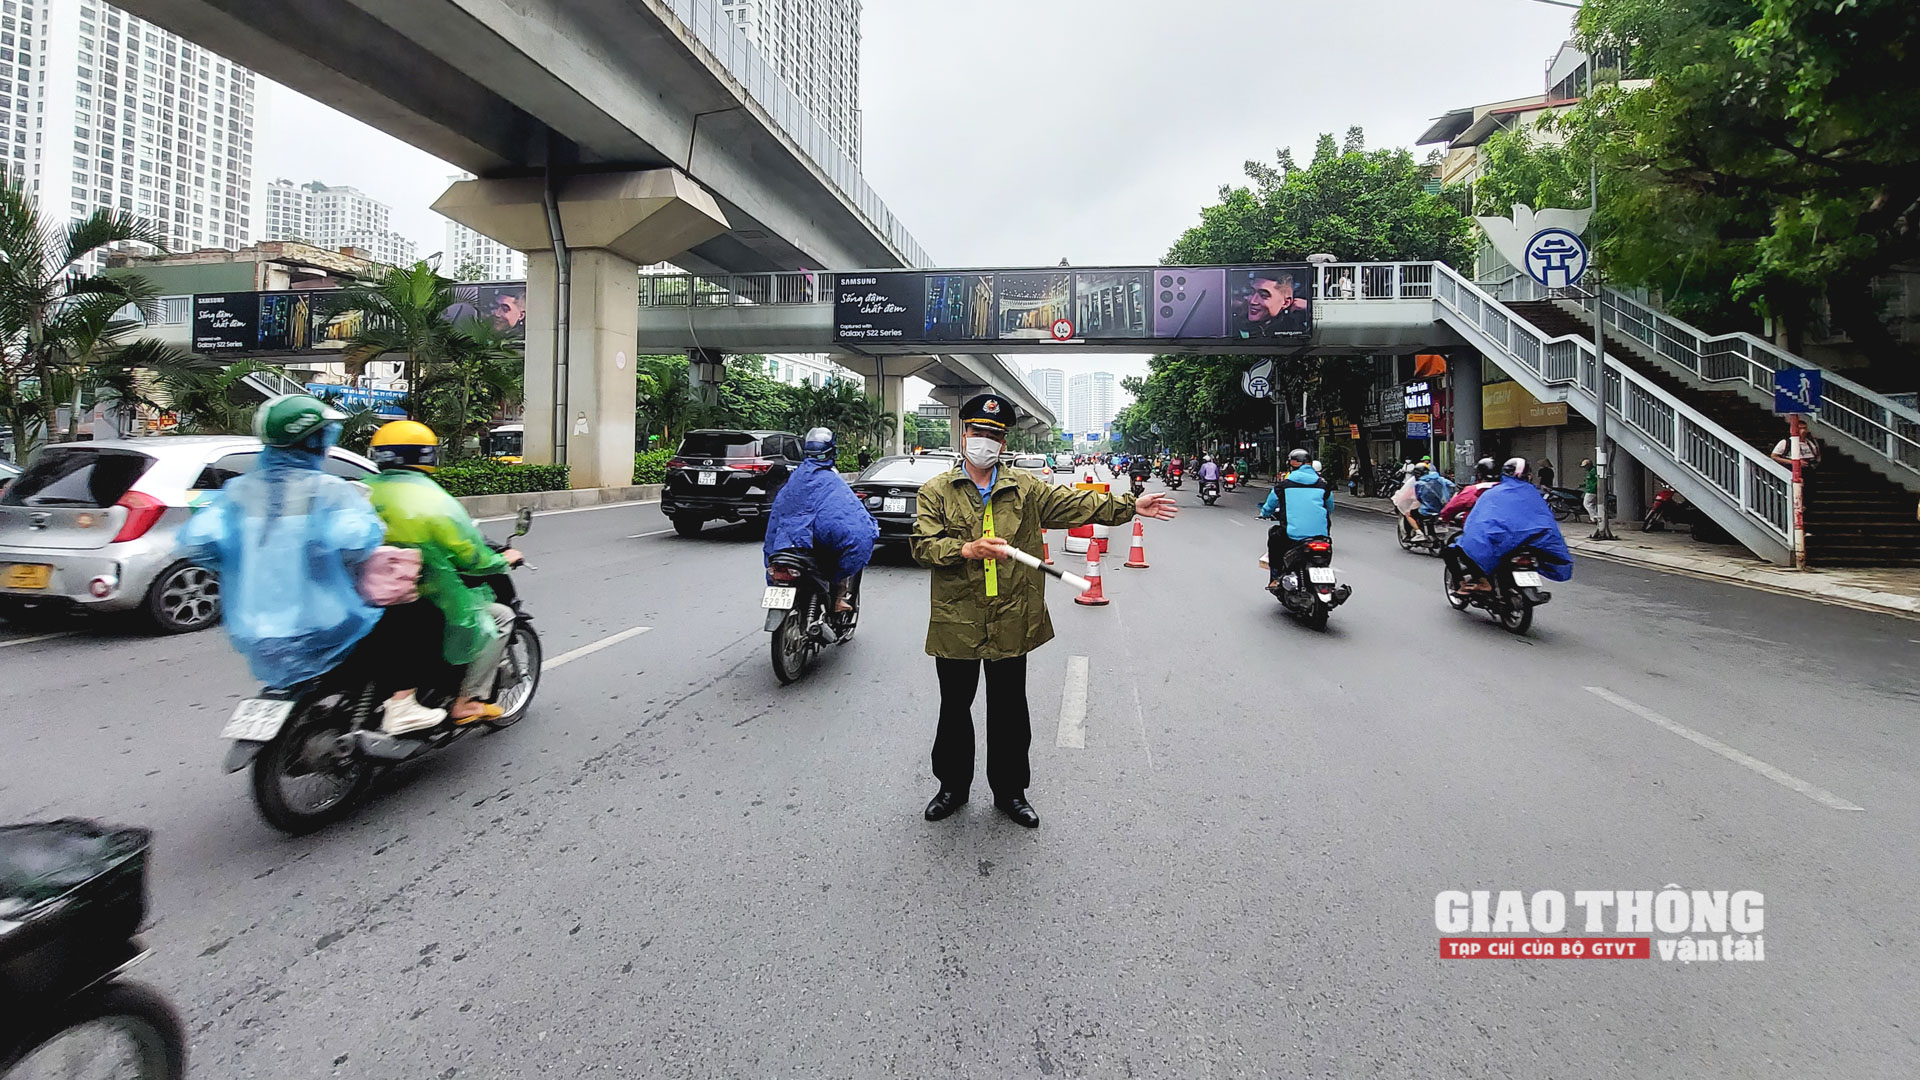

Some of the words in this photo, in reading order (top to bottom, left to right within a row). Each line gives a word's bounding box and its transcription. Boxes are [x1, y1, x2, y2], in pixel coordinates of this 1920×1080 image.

[841, 278, 877, 286] SAMSUNG
[841, 293, 863, 307] Sống
[861, 303, 883, 313] chất
[840, 330, 865, 338] Galaxy
[866, 329, 879, 337] S22
[879, 328, 903, 337] Series
